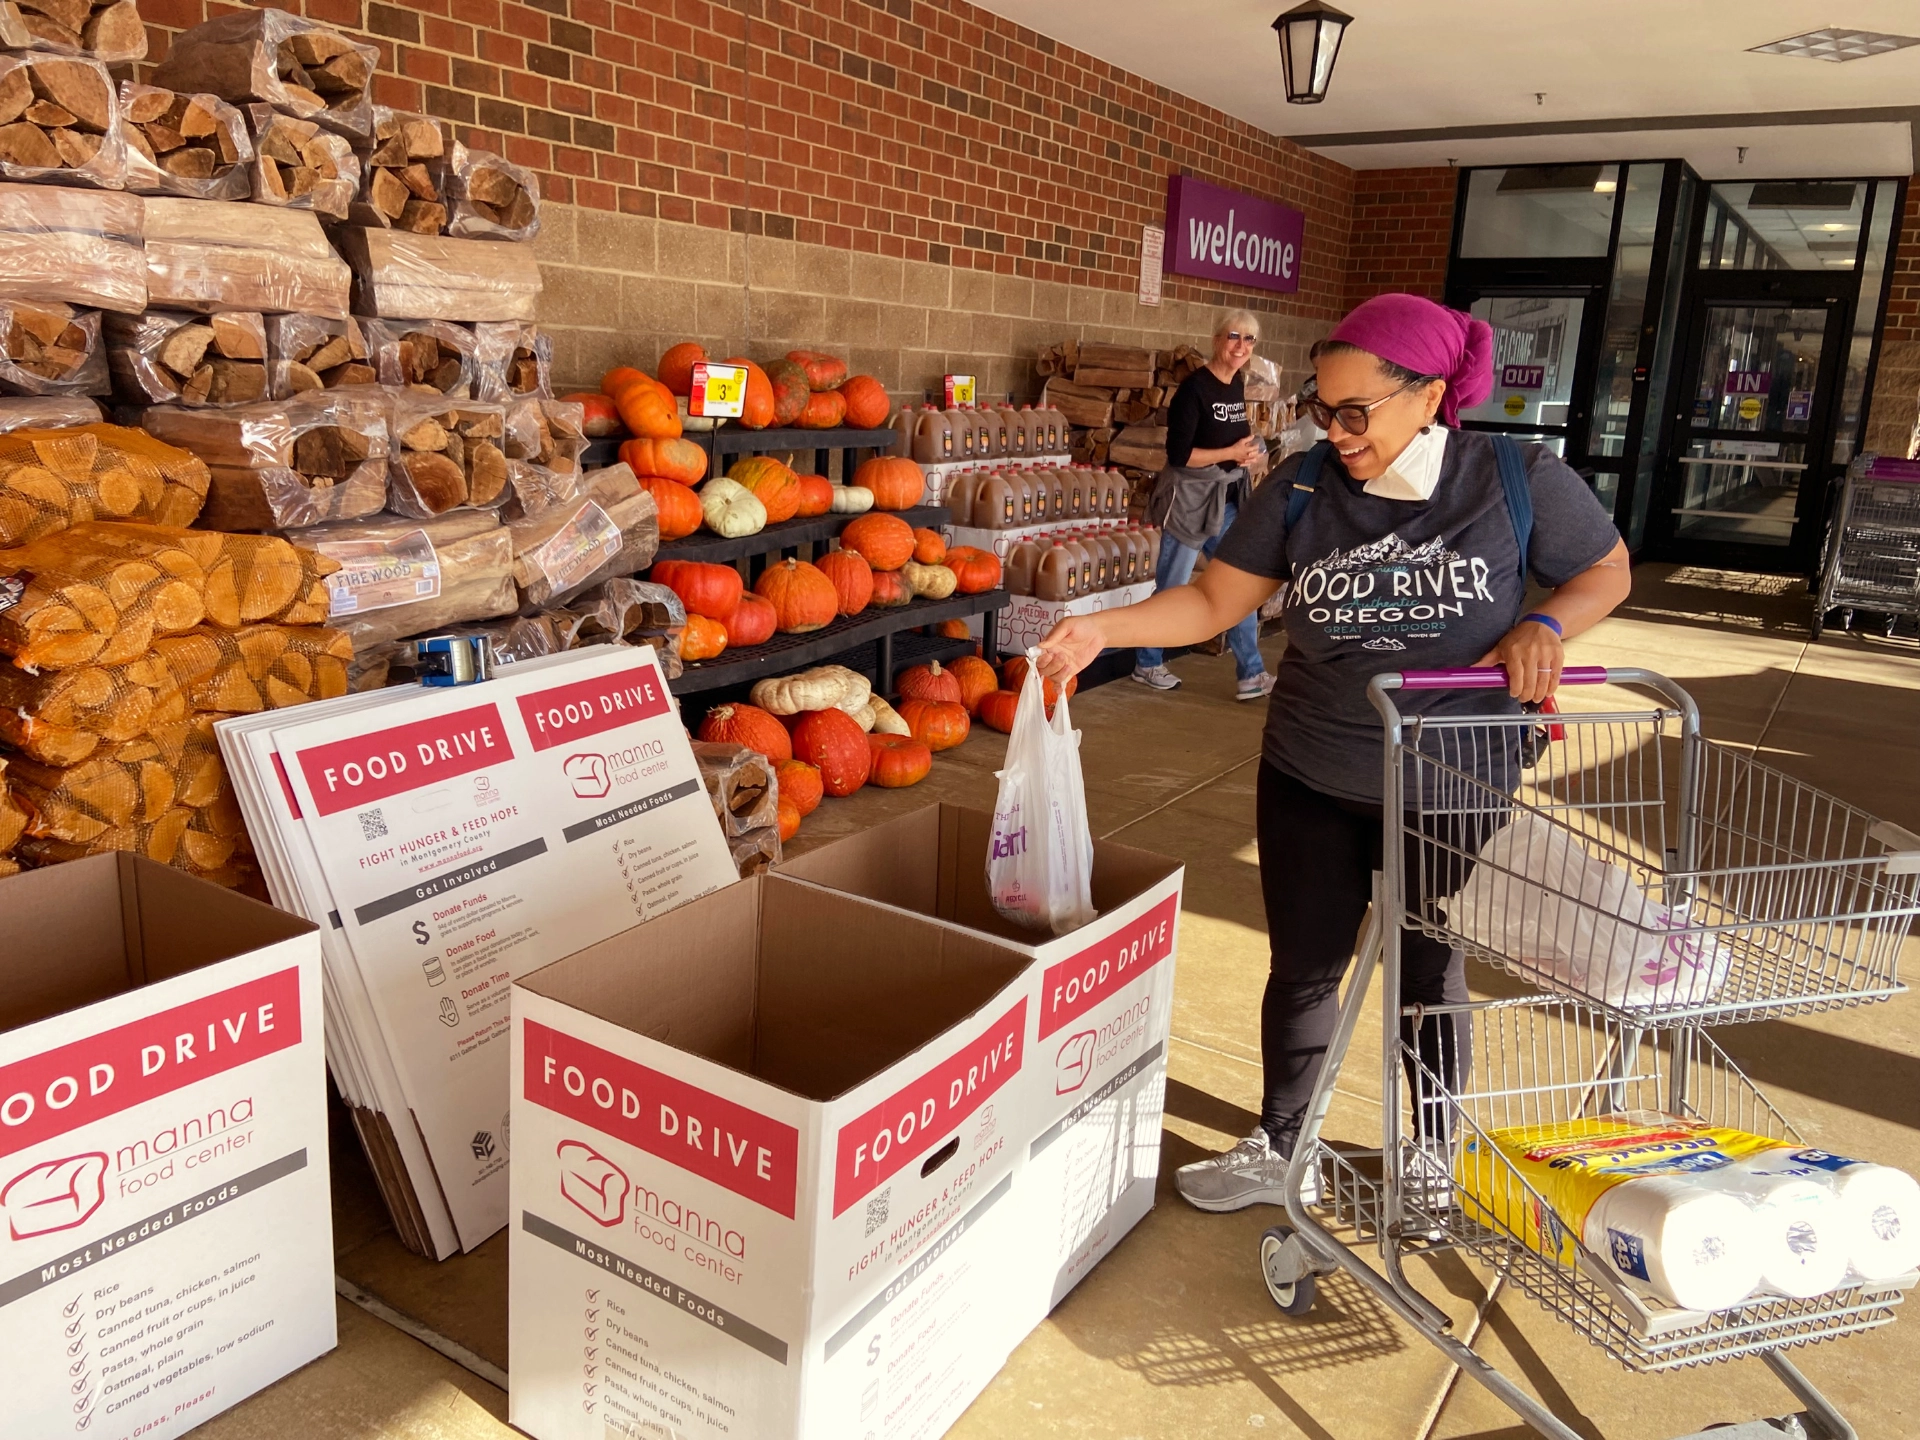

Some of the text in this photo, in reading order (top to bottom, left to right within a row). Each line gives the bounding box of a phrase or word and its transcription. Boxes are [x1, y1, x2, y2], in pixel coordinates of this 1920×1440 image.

[1189, 209, 1294, 279] welcome
[1504, 368, 1542, 385] OUT
[1736, 373, 1761, 392] IN
[335, 564, 411, 588] FIREWOOD
[1286, 557, 1494, 608] HOOD RIVER
[1017, 606, 1050, 620] APPLE CIDER
[1308, 601, 1464, 624] OREGON
[1341, 596, 1420, 610] Authentic
[1324, 621, 1447, 634] GREAT OUTDOORS
[535, 683, 656, 733] FOOD DRIVE
[323, 726, 495, 792] FOOD DRIVE
[608, 737, 664, 770] manna
[614, 759, 670, 787] food center
[595, 790, 674, 828] Most Needed Foods
[359, 805, 519, 869] FIGHT HUNGER & FEED HOPE
[400, 829, 491, 867] in Montgomery County
[623, 838, 635, 846] Rice
[628, 845, 652, 859] Dry beans
[633, 859, 651, 872] Canned
[681, 839, 697, 850] salmon
[415, 860, 497, 899] Get Involved
[637, 872, 656, 884] Canned
[432, 893, 488, 921] Donate Funds
[446, 929, 496, 957] Donate Food
[1053, 920, 1167, 1013] FOOD DRIVE
[461, 971, 510, 1000] Donate Time
[141, 1002, 275, 1077] DRIVE
[1097, 995, 1150, 1044] manna
[1095, 1021, 1148, 1069] food center
[544, 1055, 773, 1182] FOOD DRIVE
[854, 1032, 1014, 1179] FOOD DRIVE
[1061, 1066, 1137, 1132] Most Needed Foods
[116, 1096, 253, 1172] manna
[119, 1129, 255, 1198] food center
[634, 1184, 746, 1259] manna
[848, 1136, 1004, 1281] FIGHT HUNGER & FEED HOPE
[884, 1180, 974, 1263] in Montgomery County
[41, 1183, 239, 1283] Most Needed Foods
[634, 1216, 743, 1285] food center
[1616, 1236, 1631, 1270] 48
[575, 1240, 725, 1327] Most Needed Foods
[885, 1220, 965, 1301] Get Involved
[1068, 1263, 1075, 1275] No
[94, 1283, 120, 1300] Rice
[95, 1286, 154, 1320] Dry beans
[97, 1252, 261, 1338] Canned tuna, chicken, salmon
[100, 1273, 256, 1358] Canned fruit or cups, in juice
[606, 1299, 626, 1316] Rice
[102, 1318, 204, 1377] Pasta, whole grain
[606, 1318, 649, 1348] Dry beans
[103, 1349, 184, 1395] Oatmeal, plain
[106, 1318, 275, 1414] Canned vegetables, low sodium
[605, 1338, 736, 1417] Canned tuna, chicken, salmon
[133, 1386, 216, 1437] Glass, Please!
[603, 1394, 664, 1435] Oatmeal, plain
[604, 1357, 729, 1433] Canned fruit or cups, in juice
[604, 1375, 682, 1427] Pasta, whole grain
